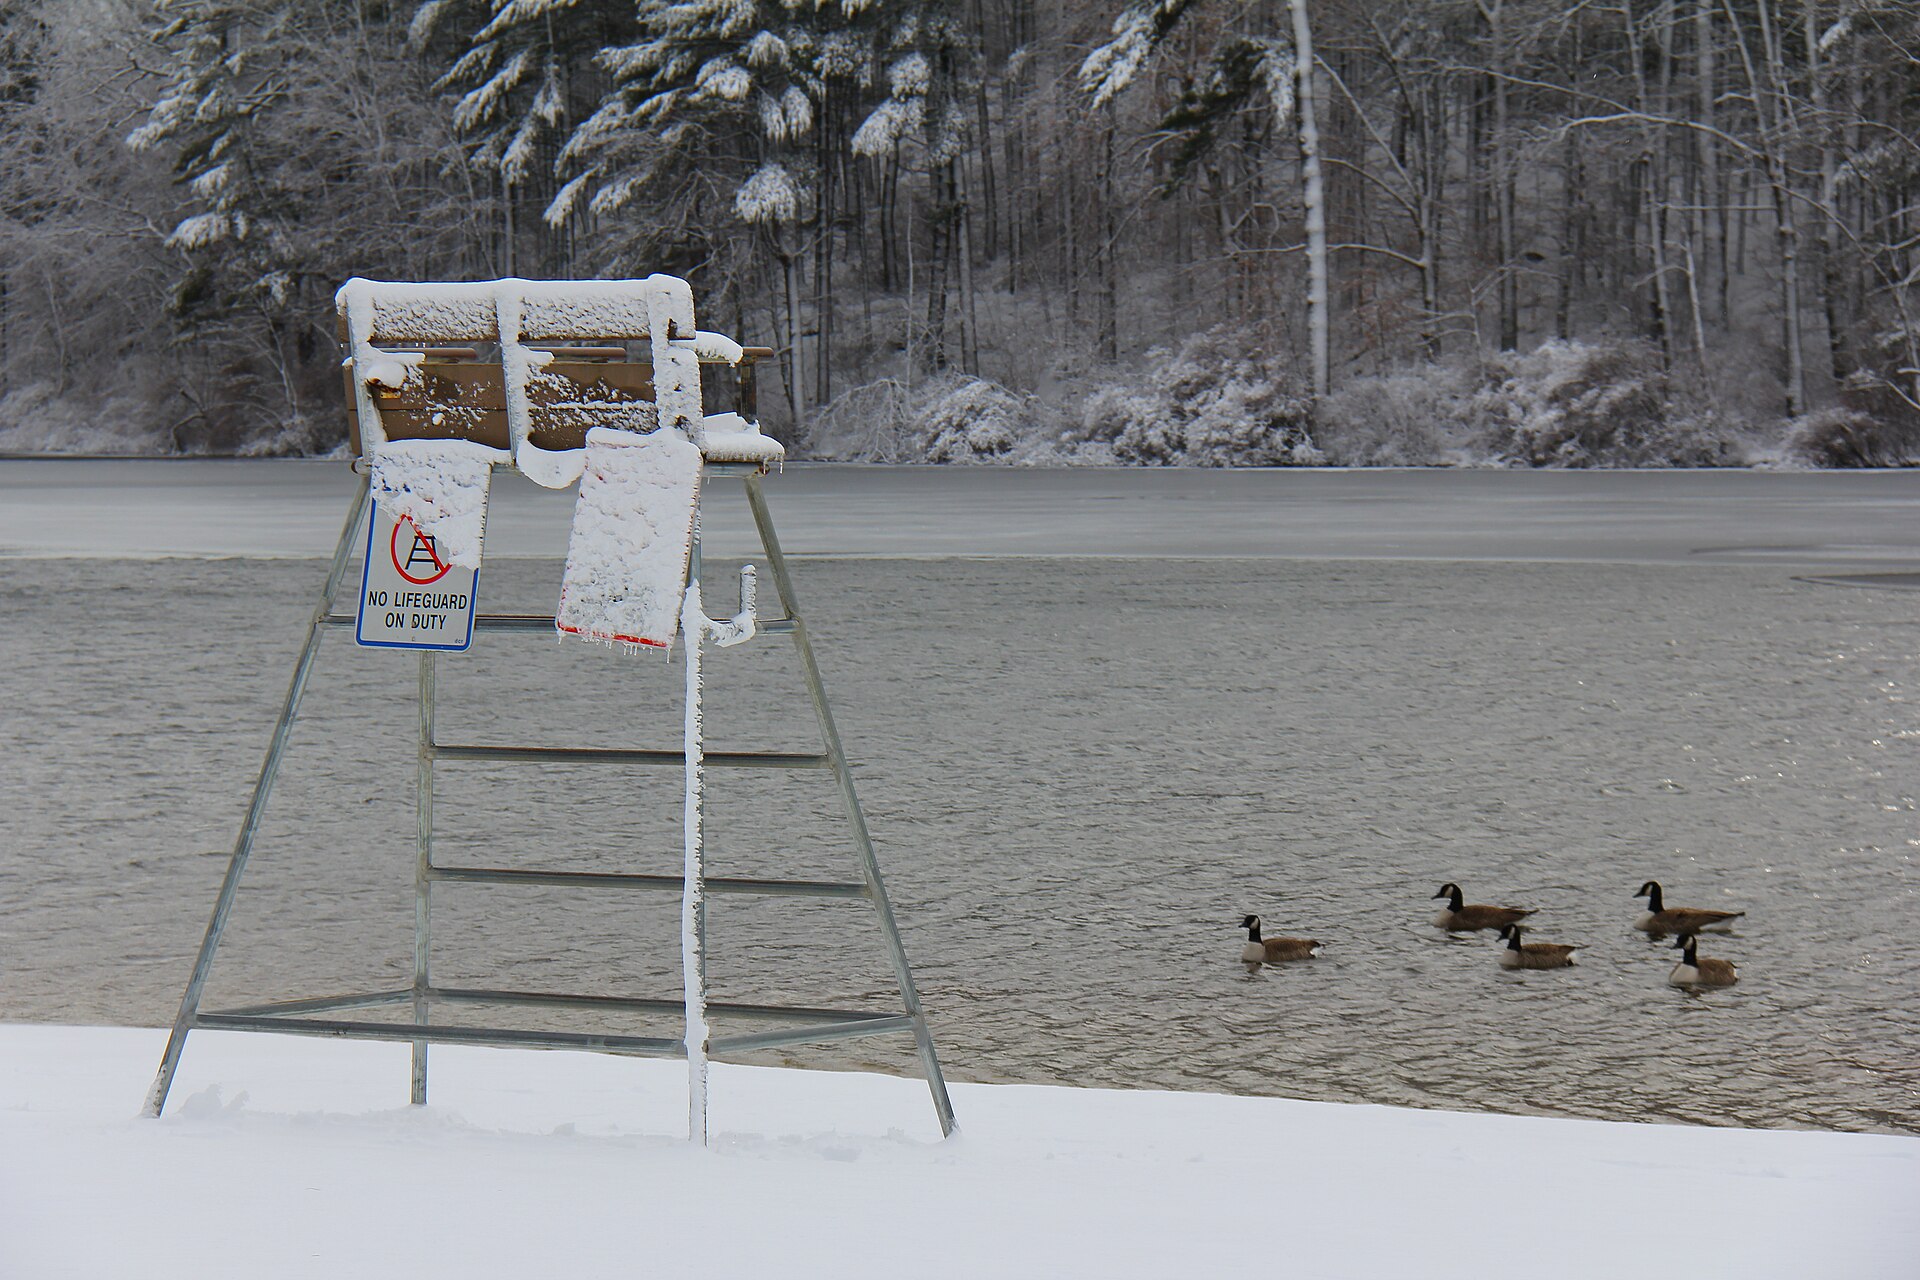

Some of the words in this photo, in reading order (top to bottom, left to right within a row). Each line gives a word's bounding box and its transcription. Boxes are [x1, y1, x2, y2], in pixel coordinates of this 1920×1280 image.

[368, 591, 388, 606] NO
[394, 592, 468, 610] LIFEGUARD
[385, 612, 405, 628] ON
[411, 613, 447, 629] DUTY
